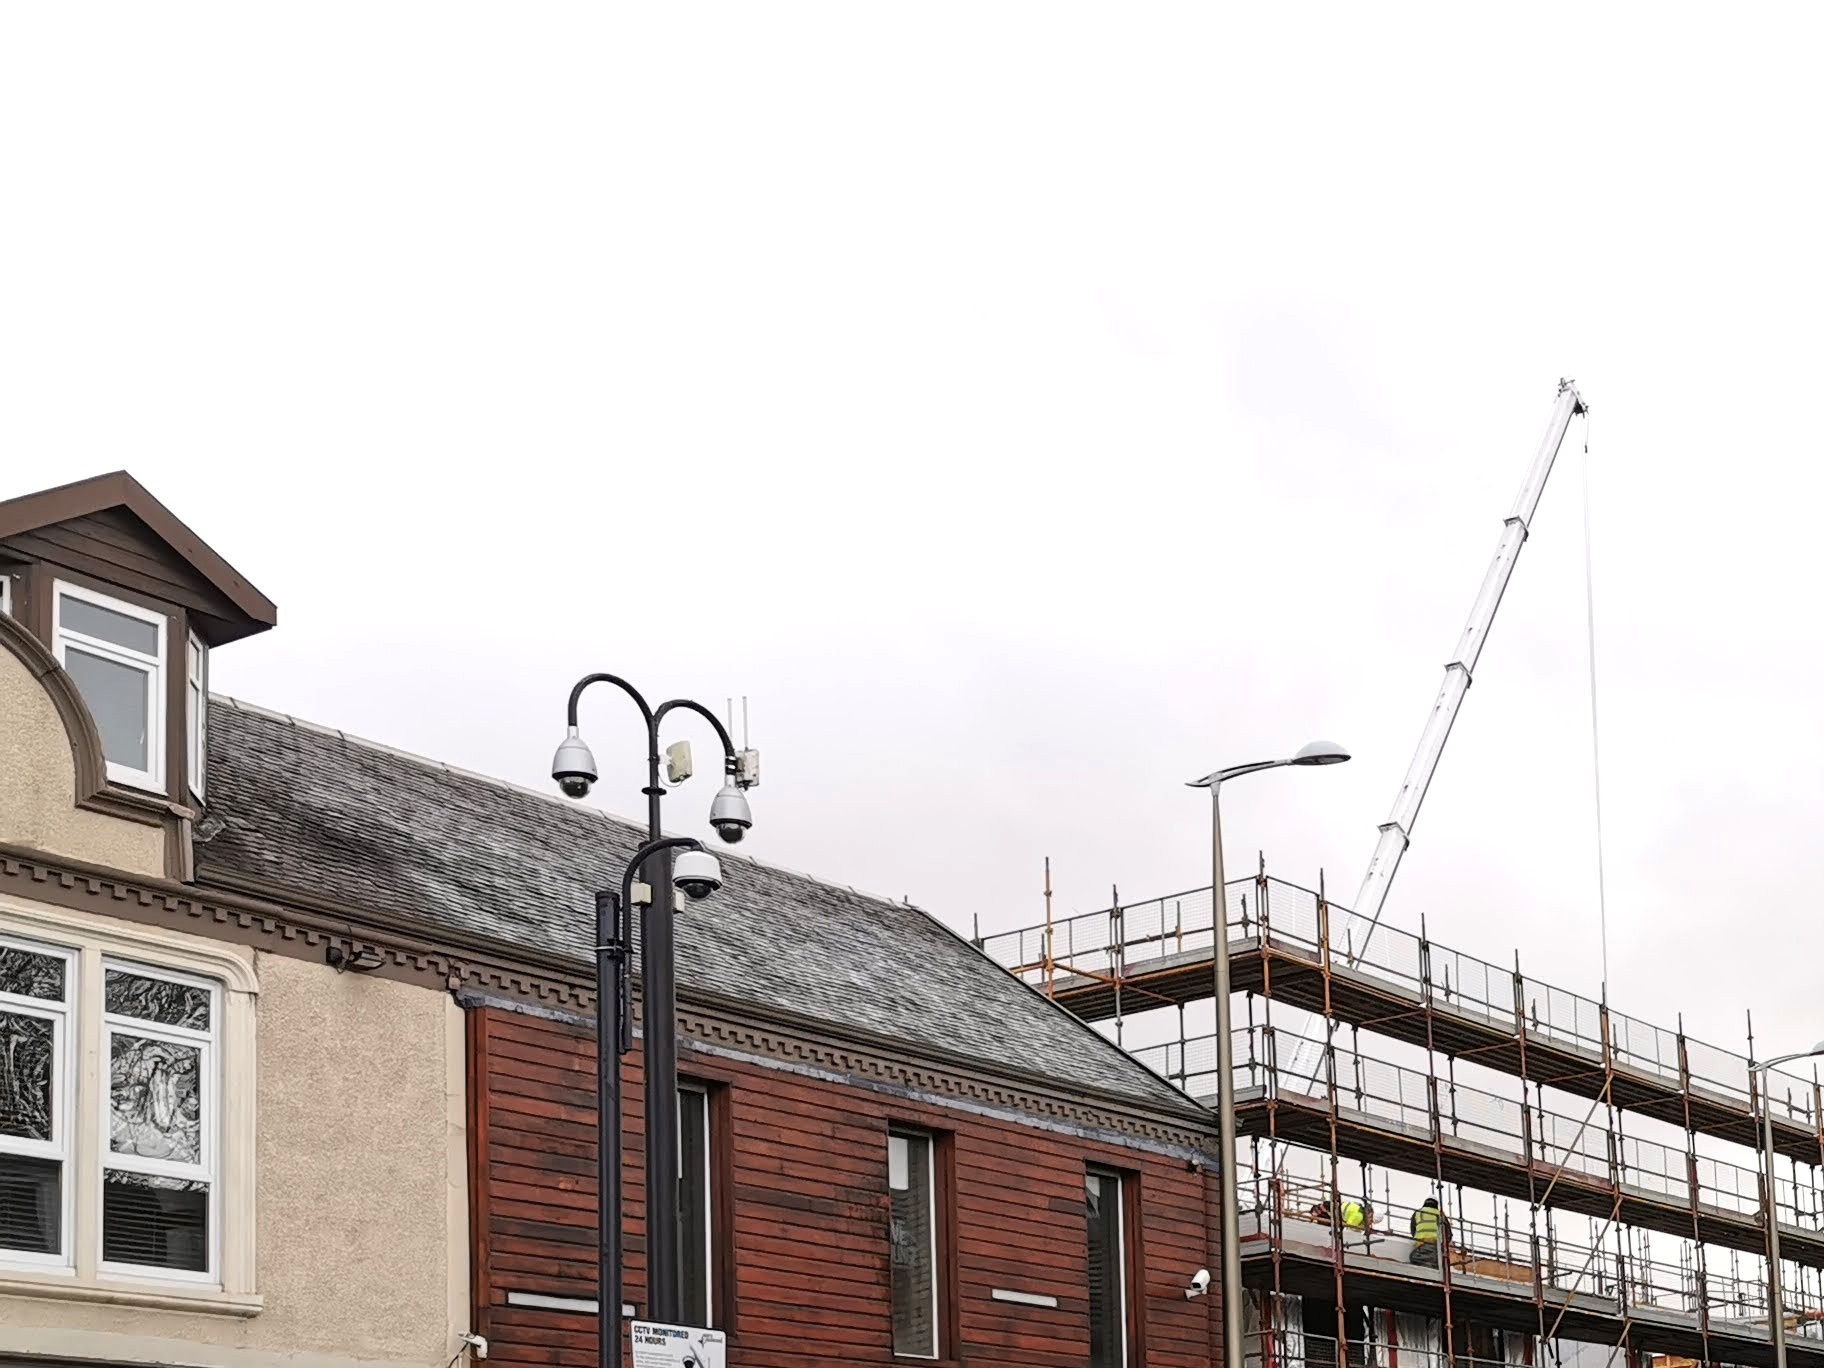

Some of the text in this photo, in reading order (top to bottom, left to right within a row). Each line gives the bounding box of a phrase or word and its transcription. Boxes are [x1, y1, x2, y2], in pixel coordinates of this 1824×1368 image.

[634, 1325, 650, 1335] CCTV
[652, 1327, 689, 1339] MONITORED
[634, 1335, 666, 1346] 24 HOURS
